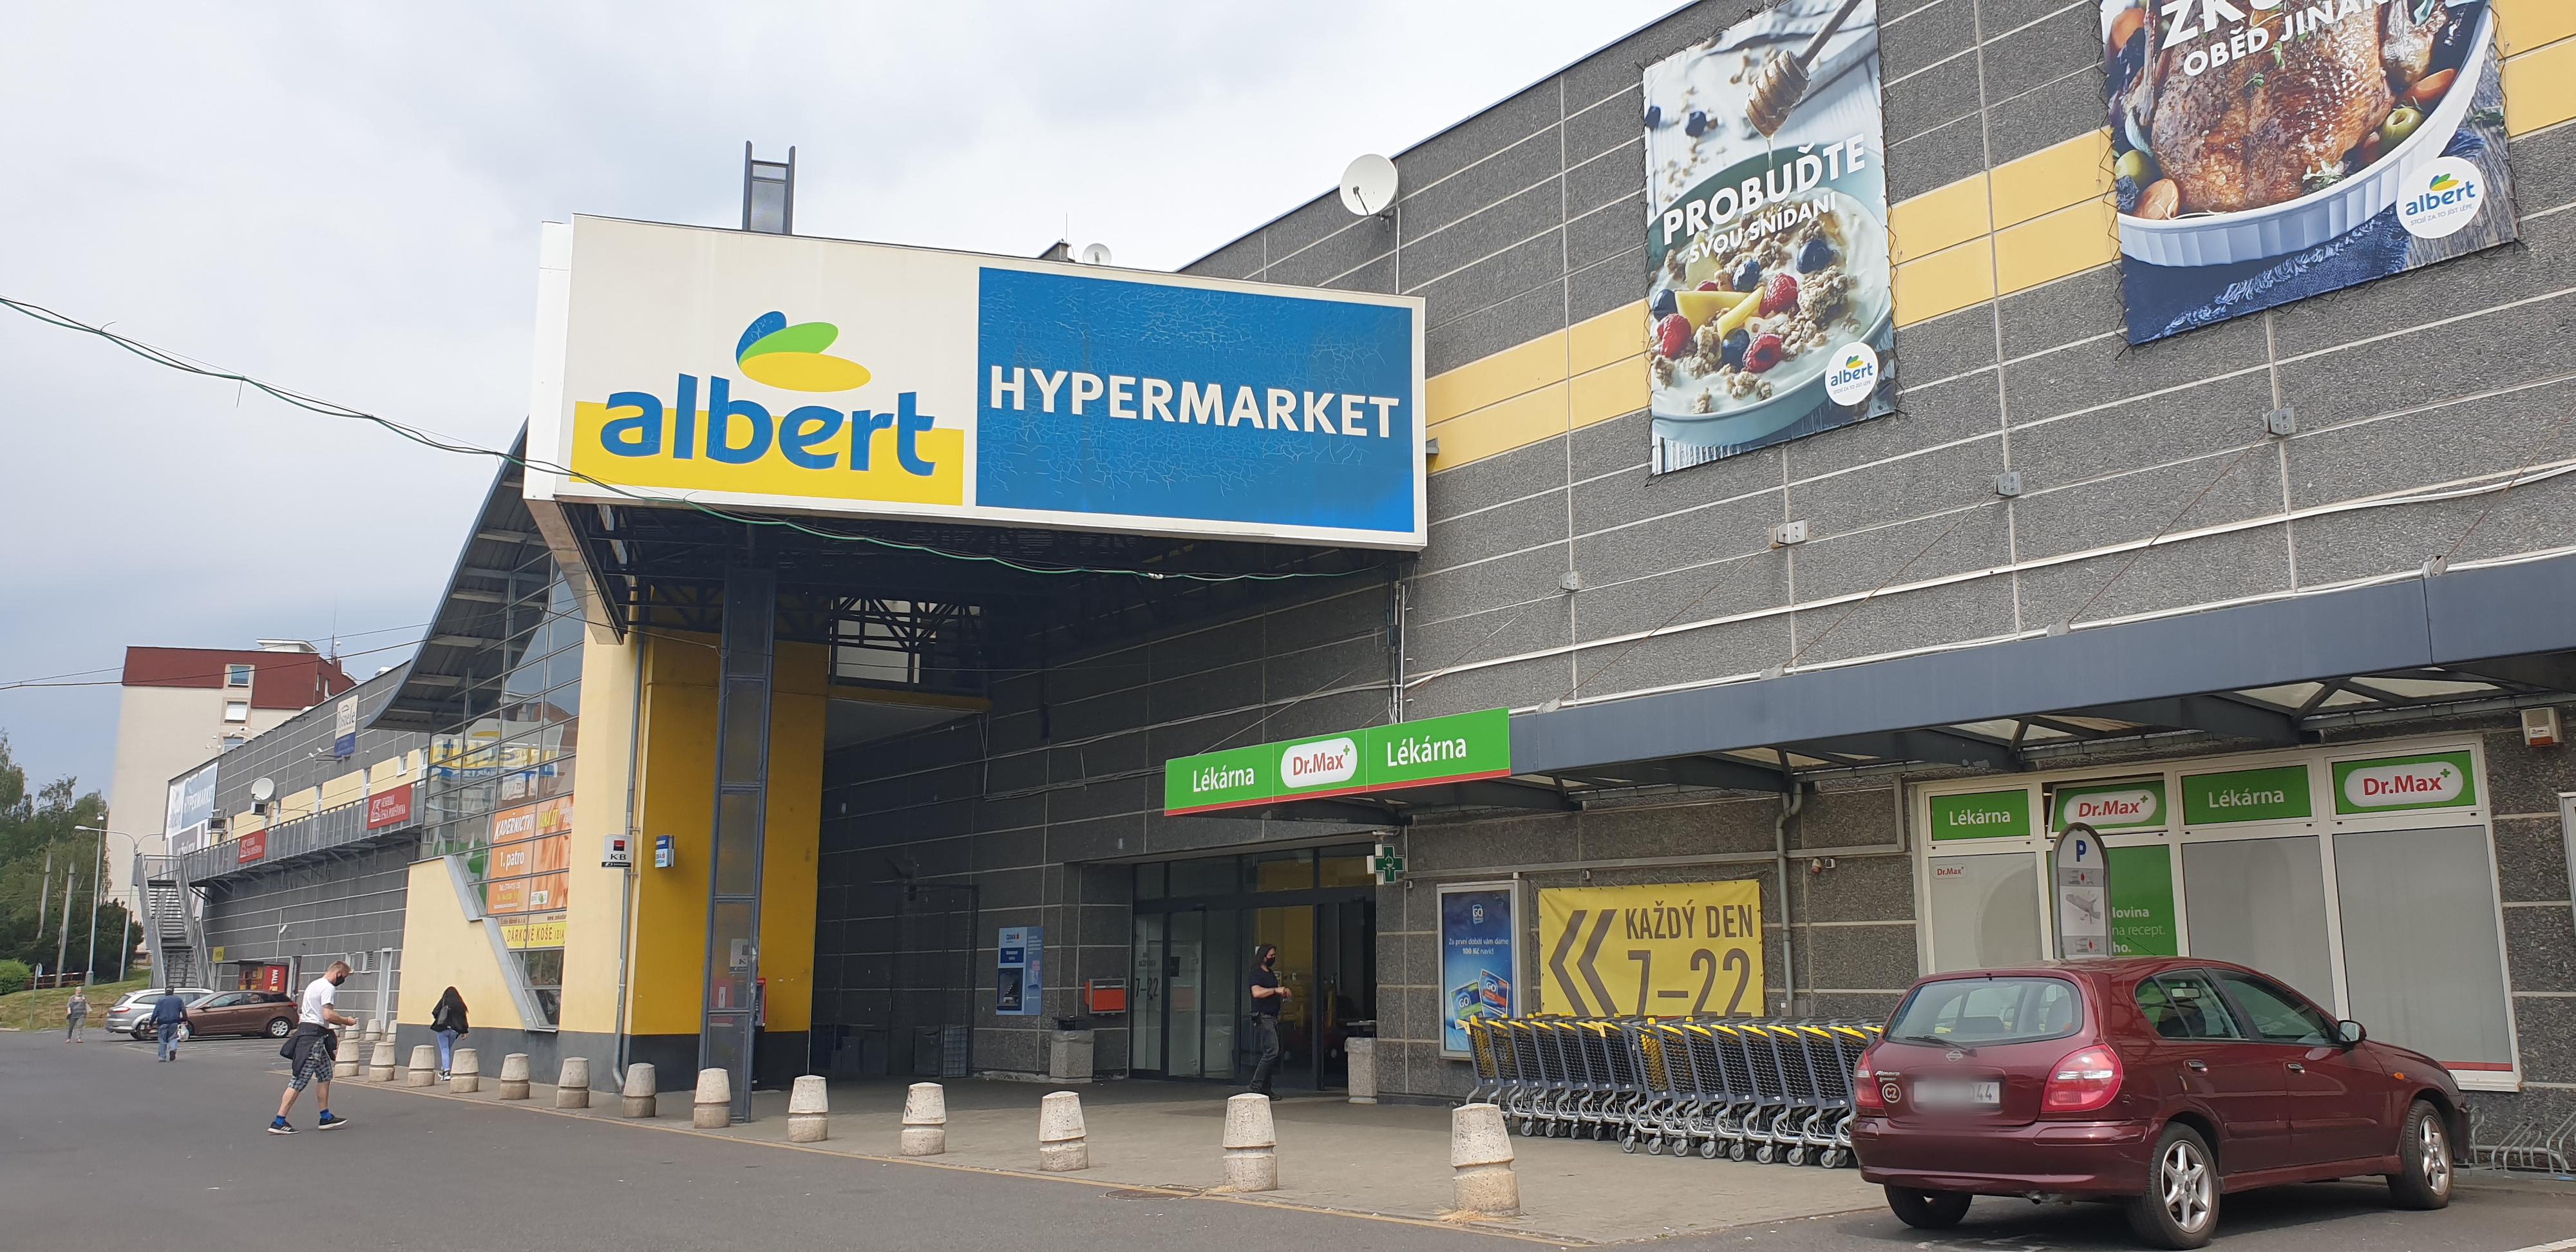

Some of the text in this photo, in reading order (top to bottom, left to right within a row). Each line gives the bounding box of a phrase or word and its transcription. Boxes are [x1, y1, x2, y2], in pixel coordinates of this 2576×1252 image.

[2161, 0, 2281, 50] ZK
[2184, 26, 2269, 76] OBĚD
[1663, 133, 1865, 245] PROBUĎTE
[2406, 181, 2476, 216] albert
[1690, 191, 1835, 263] SVOU SNÍDANI
[2410, 216, 2426, 225] STOJÍ
[1831, 363, 1873, 386] albert
[990, 365, 1399, 438] HYPERMARKET
[600, 373, 936, 476] albert
[1387, 736, 1466, 766] Lékárna
[1193, 752, 1344, 793] Lékárna Dr.Max
[2208, 775, 2442, 808] Lékárna Dr.Max
[1949, 801, 2139, 825] Lékárna Dr.Max
[494, 810, 536, 841] KADEŘNICTVÍ
[500, 850, 525, 871] 1. patro
[2076, 840, 2087, 862] P
[1473, 908, 1483, 917] GO
[1625, 899, 1753, 939] KAŽDÝ DEN
[2112, 907, 2150, 918] lovina
[507, 926, 534, 942] DÁRKOVÉ
[536, 925, 553, 940] KOŠE
[2128, 925, 2166, 937] recept.
[2113, 942, 2132, 953] ho.
[1486, 982, 1496, 992] GO
[1459, 997, 1469, 1008] GO
[1885, 1087, 1897, 1099] CZ
